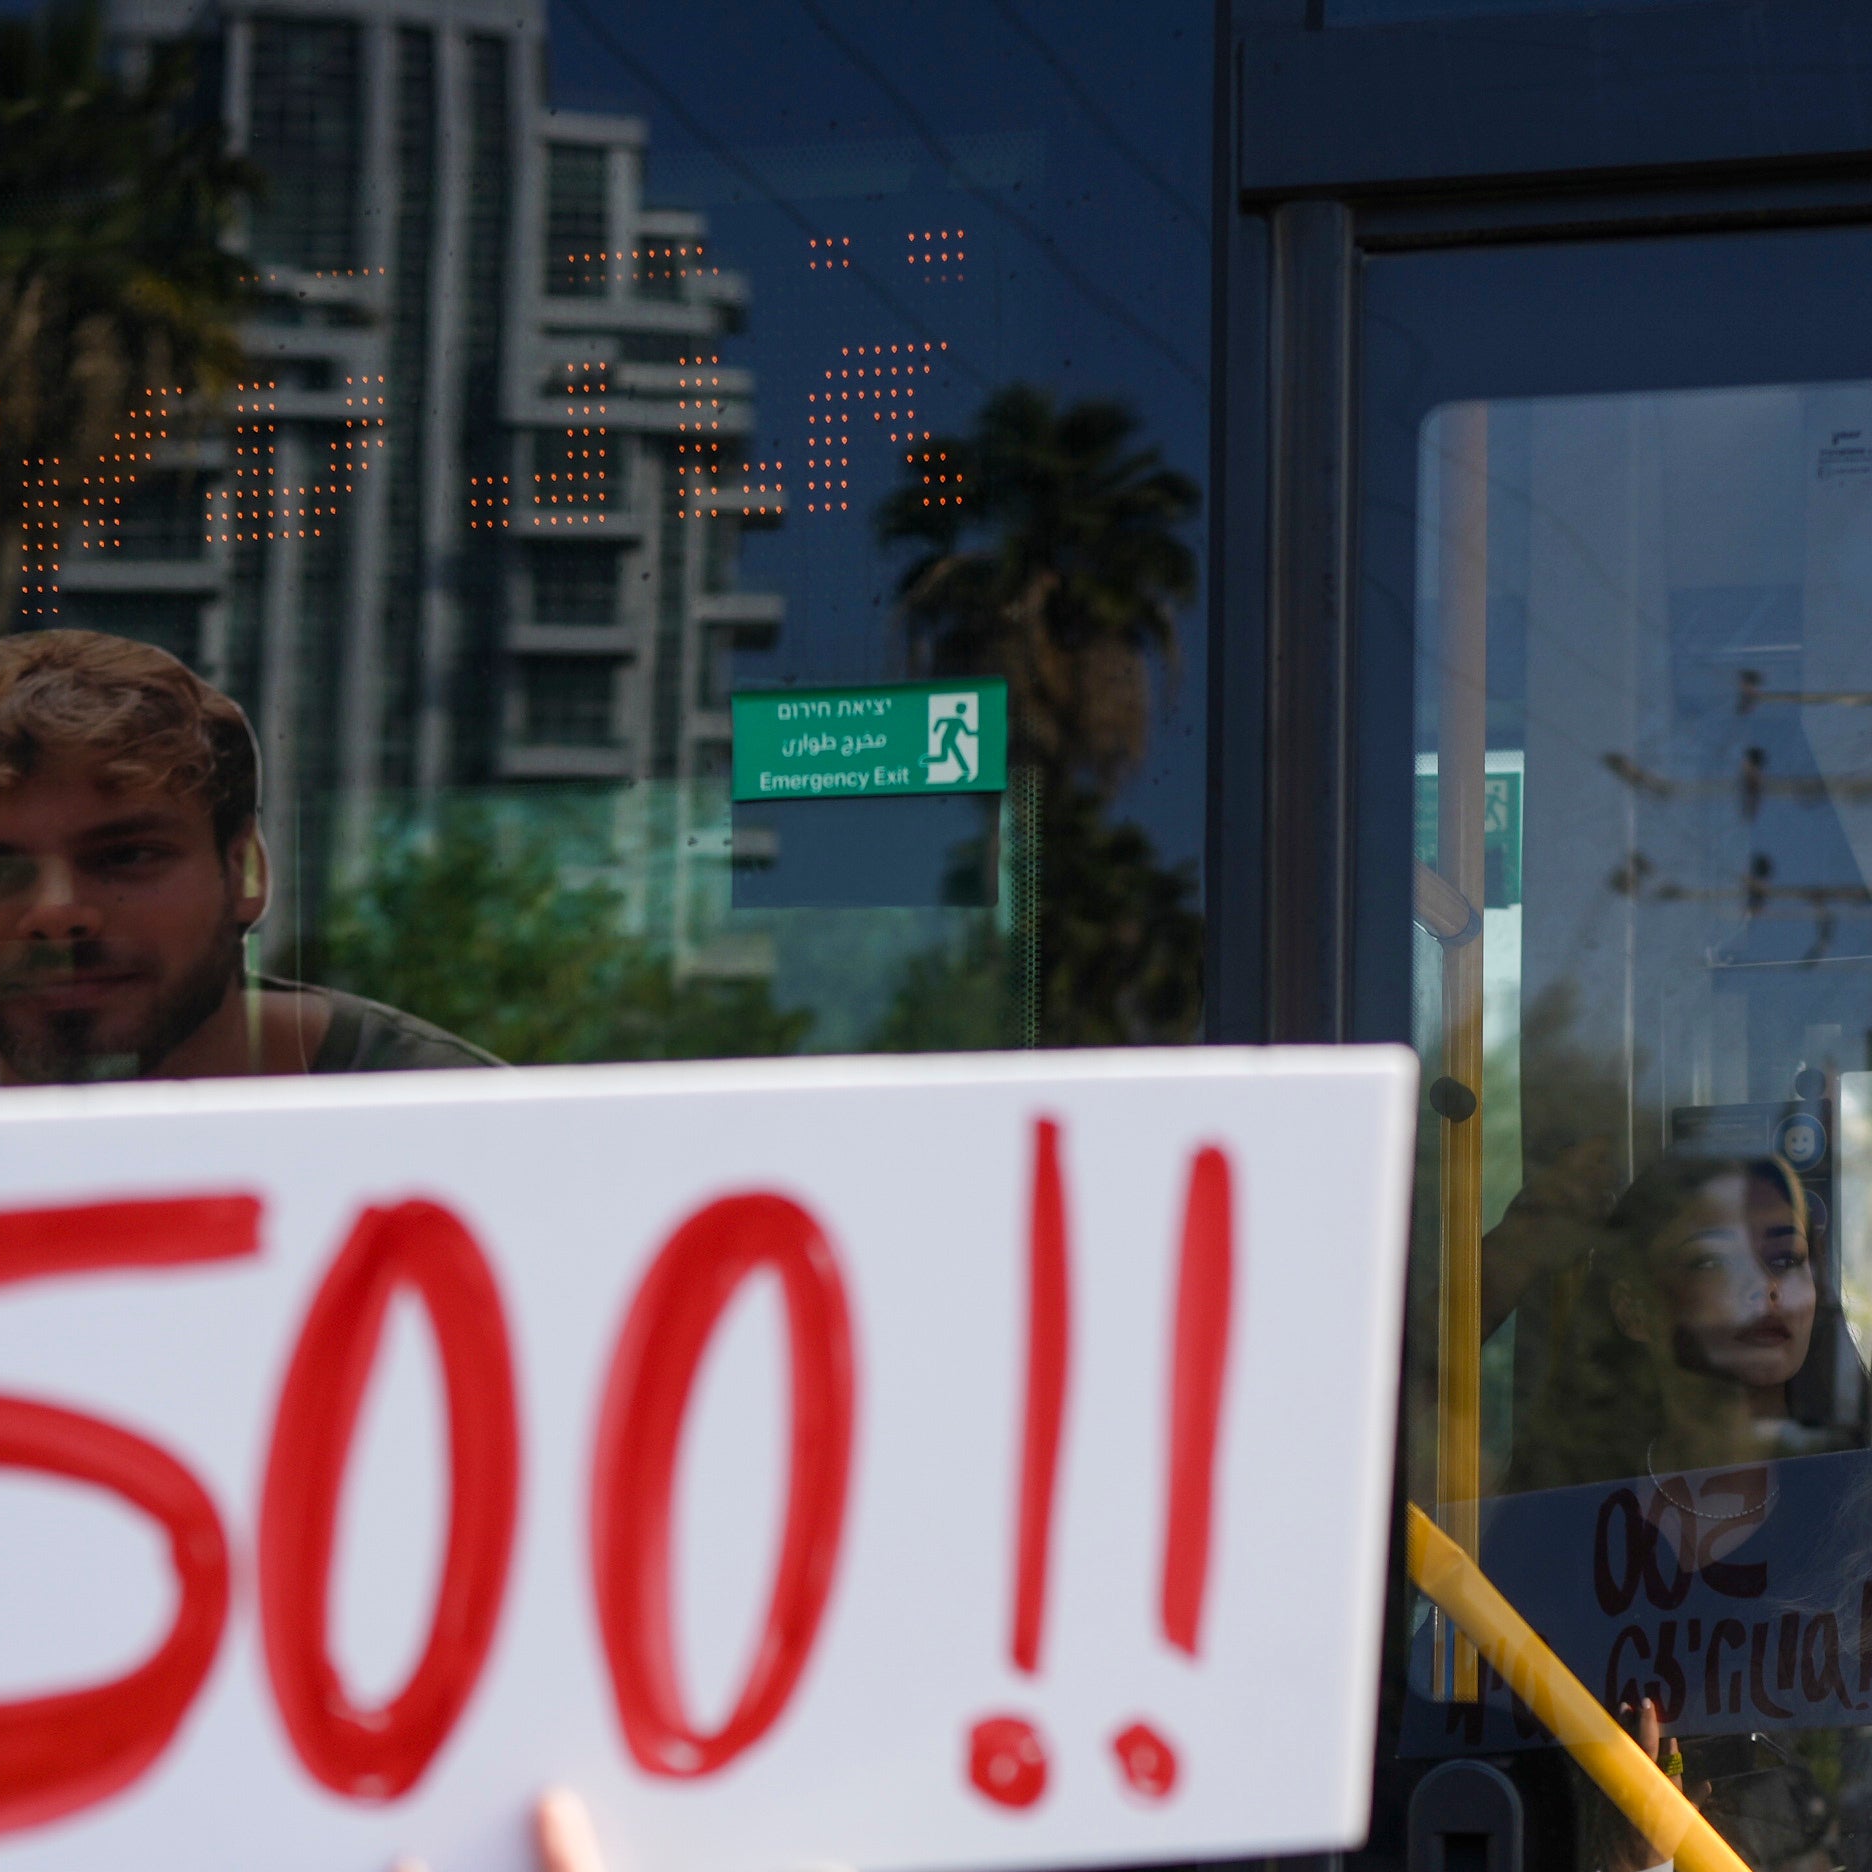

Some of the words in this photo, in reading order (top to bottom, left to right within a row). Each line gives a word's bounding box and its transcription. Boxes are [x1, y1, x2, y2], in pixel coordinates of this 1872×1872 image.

[777, 700, 832, 721] חירום
[837, 697, 893, 718] יציאת
[759, 771, 870, 794] Emergency
[873, 765, 910, 786] Exit
